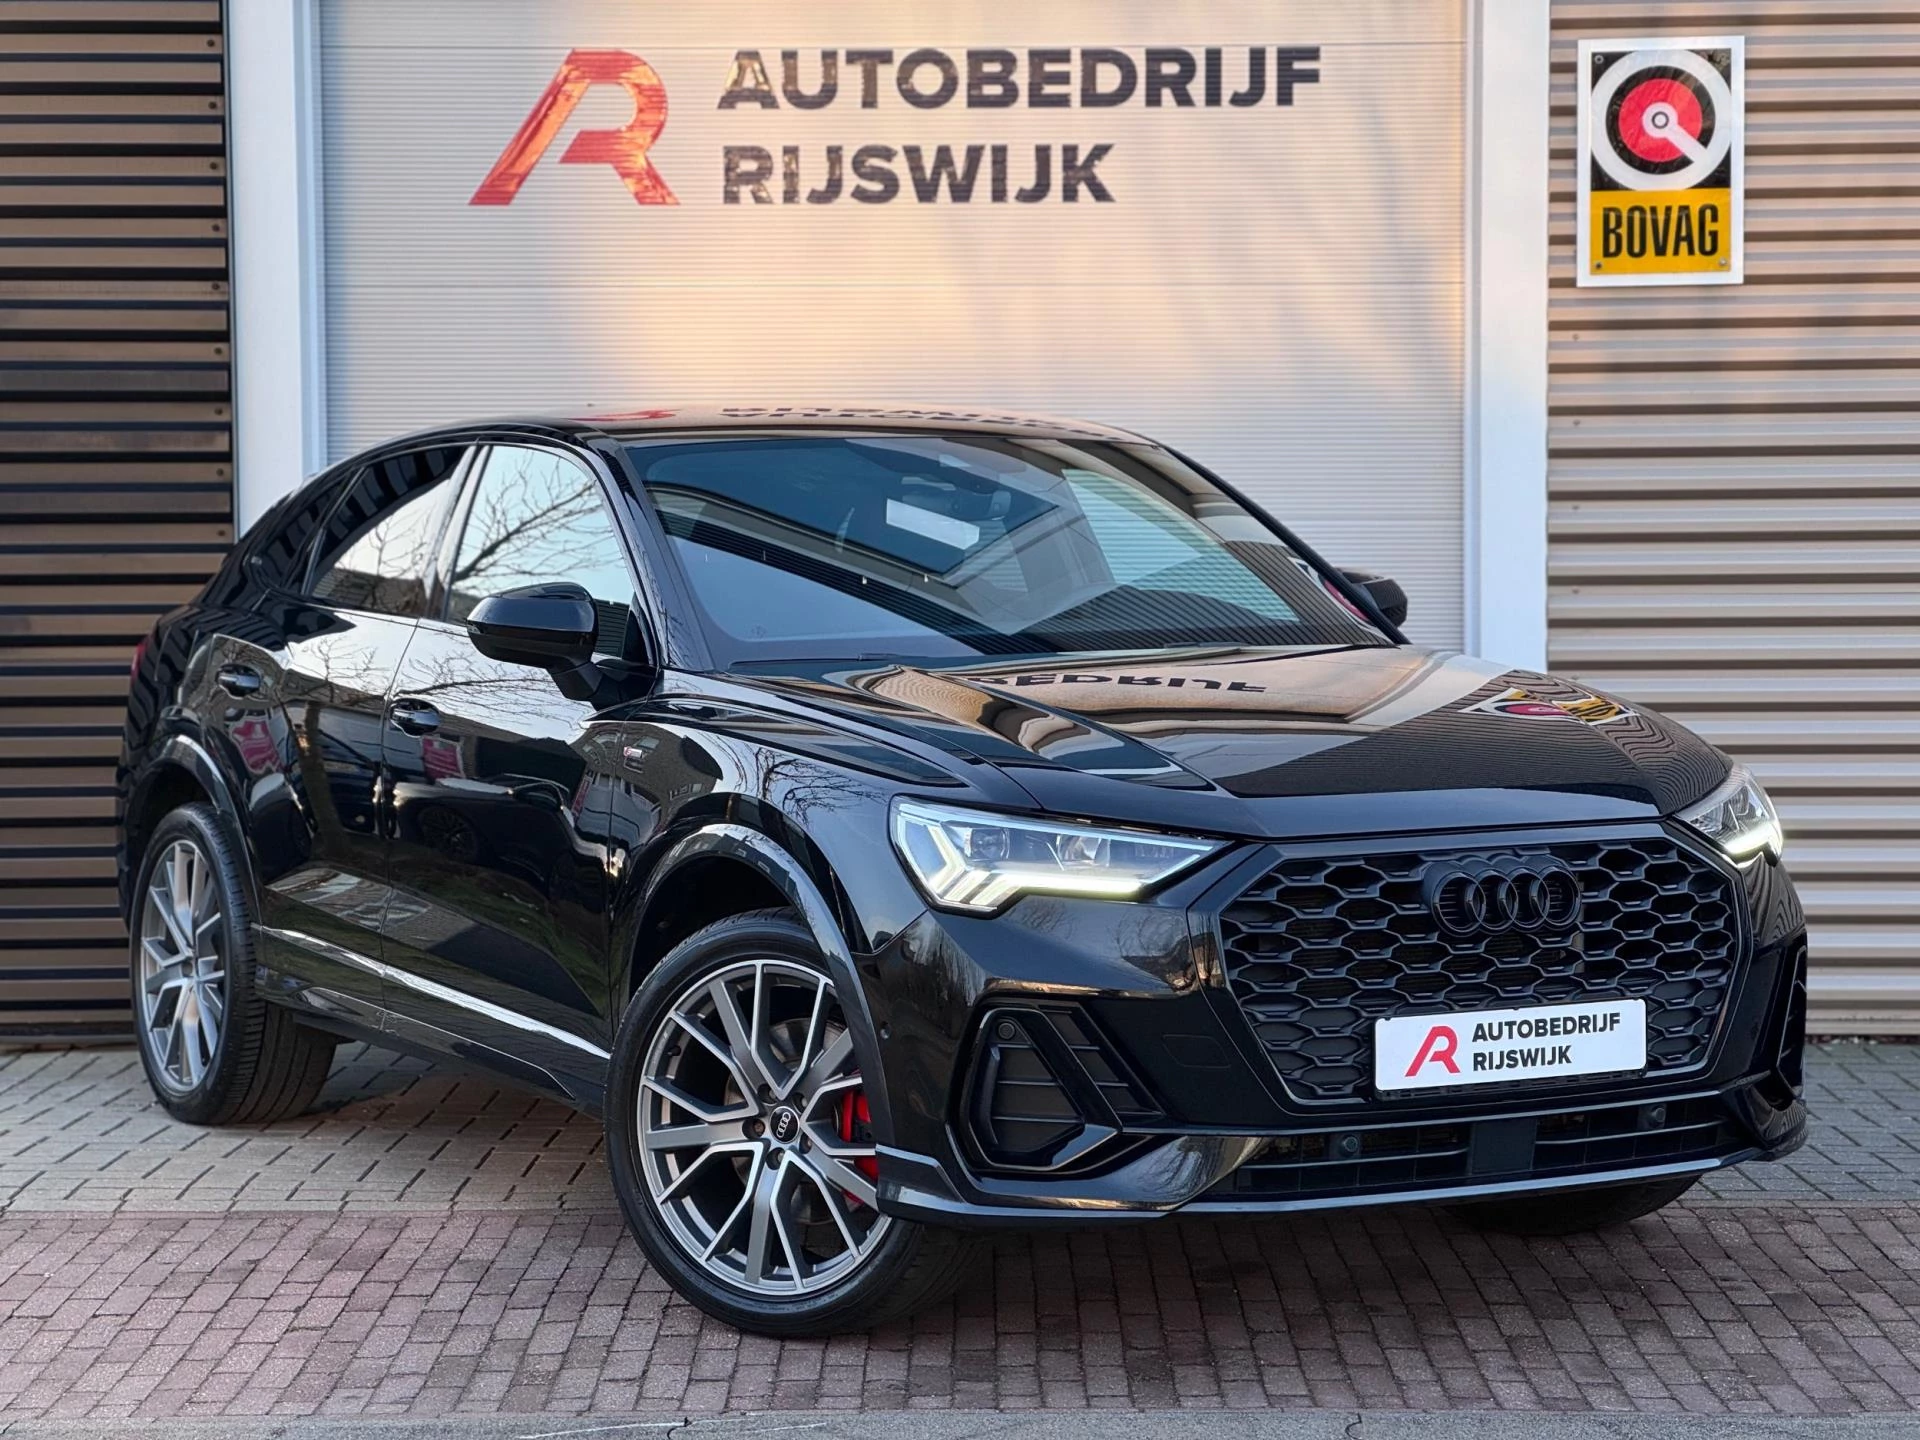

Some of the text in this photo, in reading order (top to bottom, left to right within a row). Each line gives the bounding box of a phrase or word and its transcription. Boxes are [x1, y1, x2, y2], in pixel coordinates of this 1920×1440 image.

[717, 47, 1321, 110] AUTOBEDRIJF
[722, 143, 1116, 205] RIJSWIJK
[1601, 203, 1719, 258] BOVAG
[1471, 1012, 1621, 1043] AUTOBEDRIJF
[1472, 1045, 1572, 1072] RIJSWIJK
